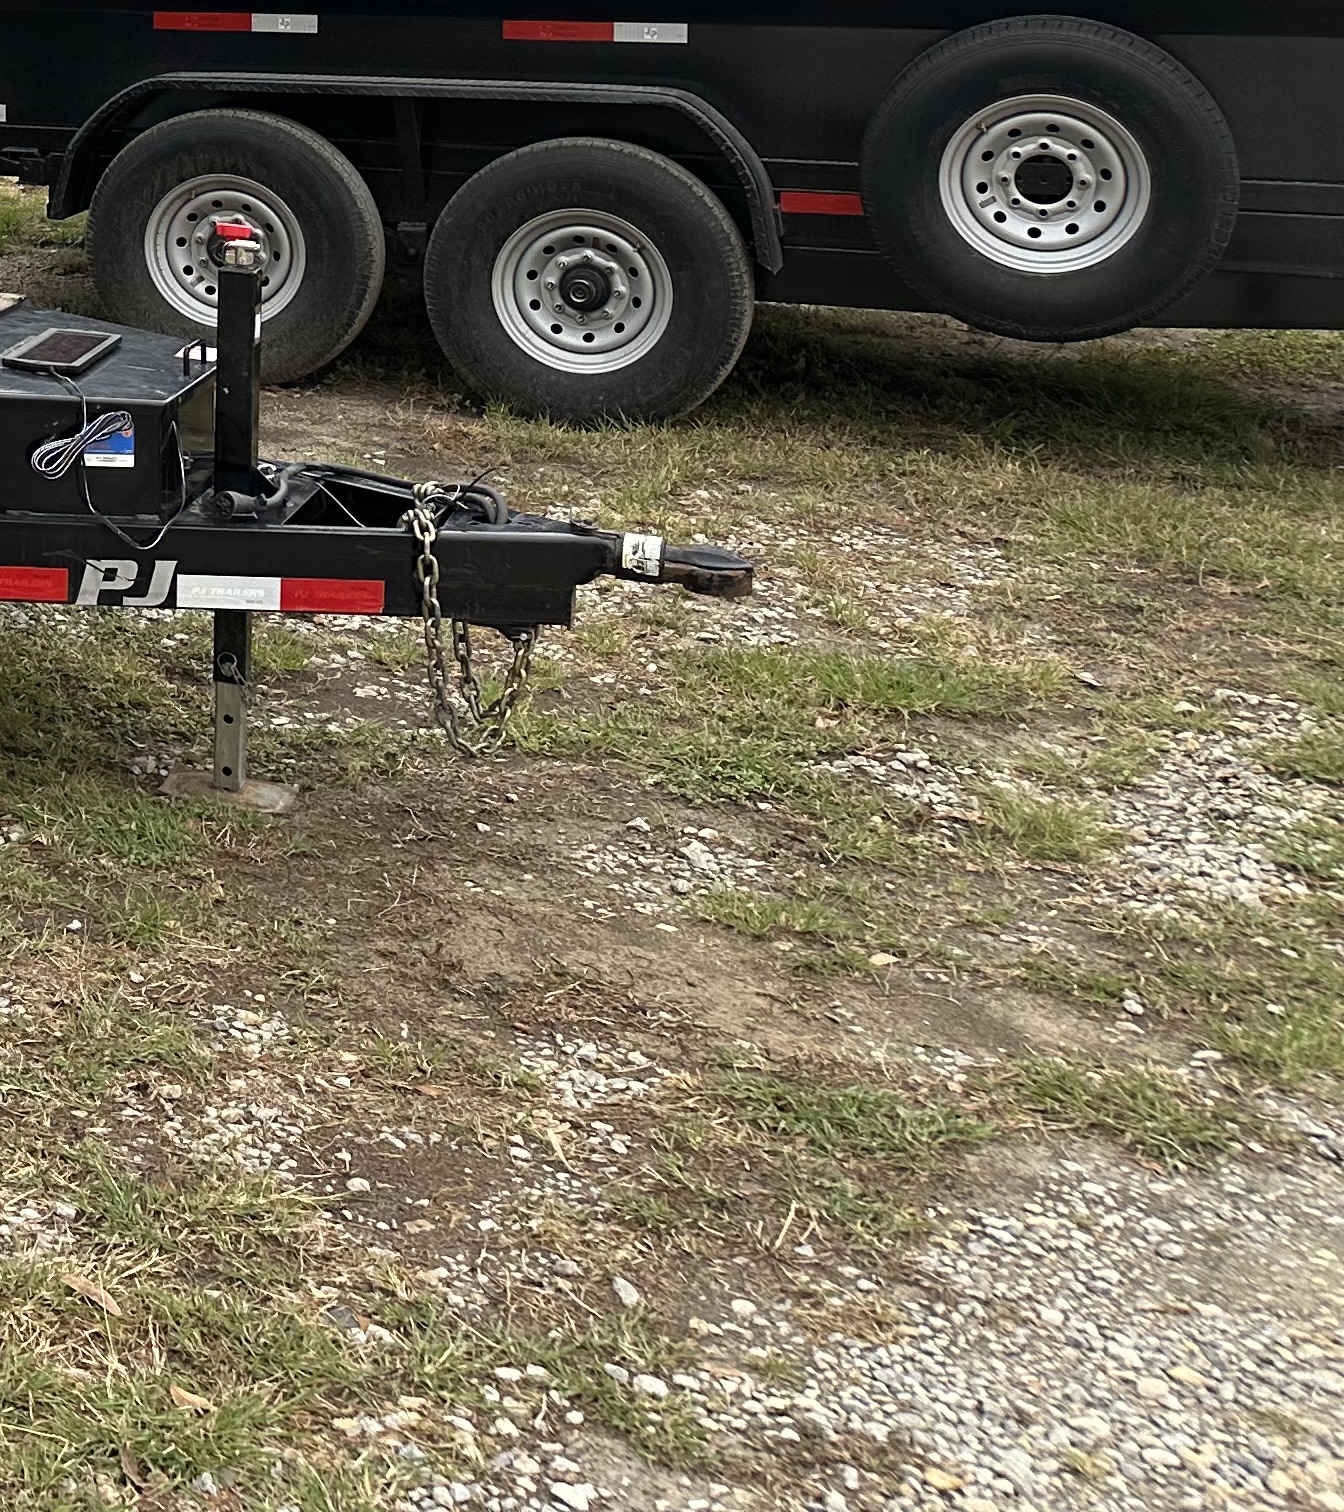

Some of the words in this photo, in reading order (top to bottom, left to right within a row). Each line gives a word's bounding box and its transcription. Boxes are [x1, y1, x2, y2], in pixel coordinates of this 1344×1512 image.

[74, 559, 178, 606] PJ
[191, 586, 206, 596] PJ
[210, 587, 265, 598] TRAILERS
